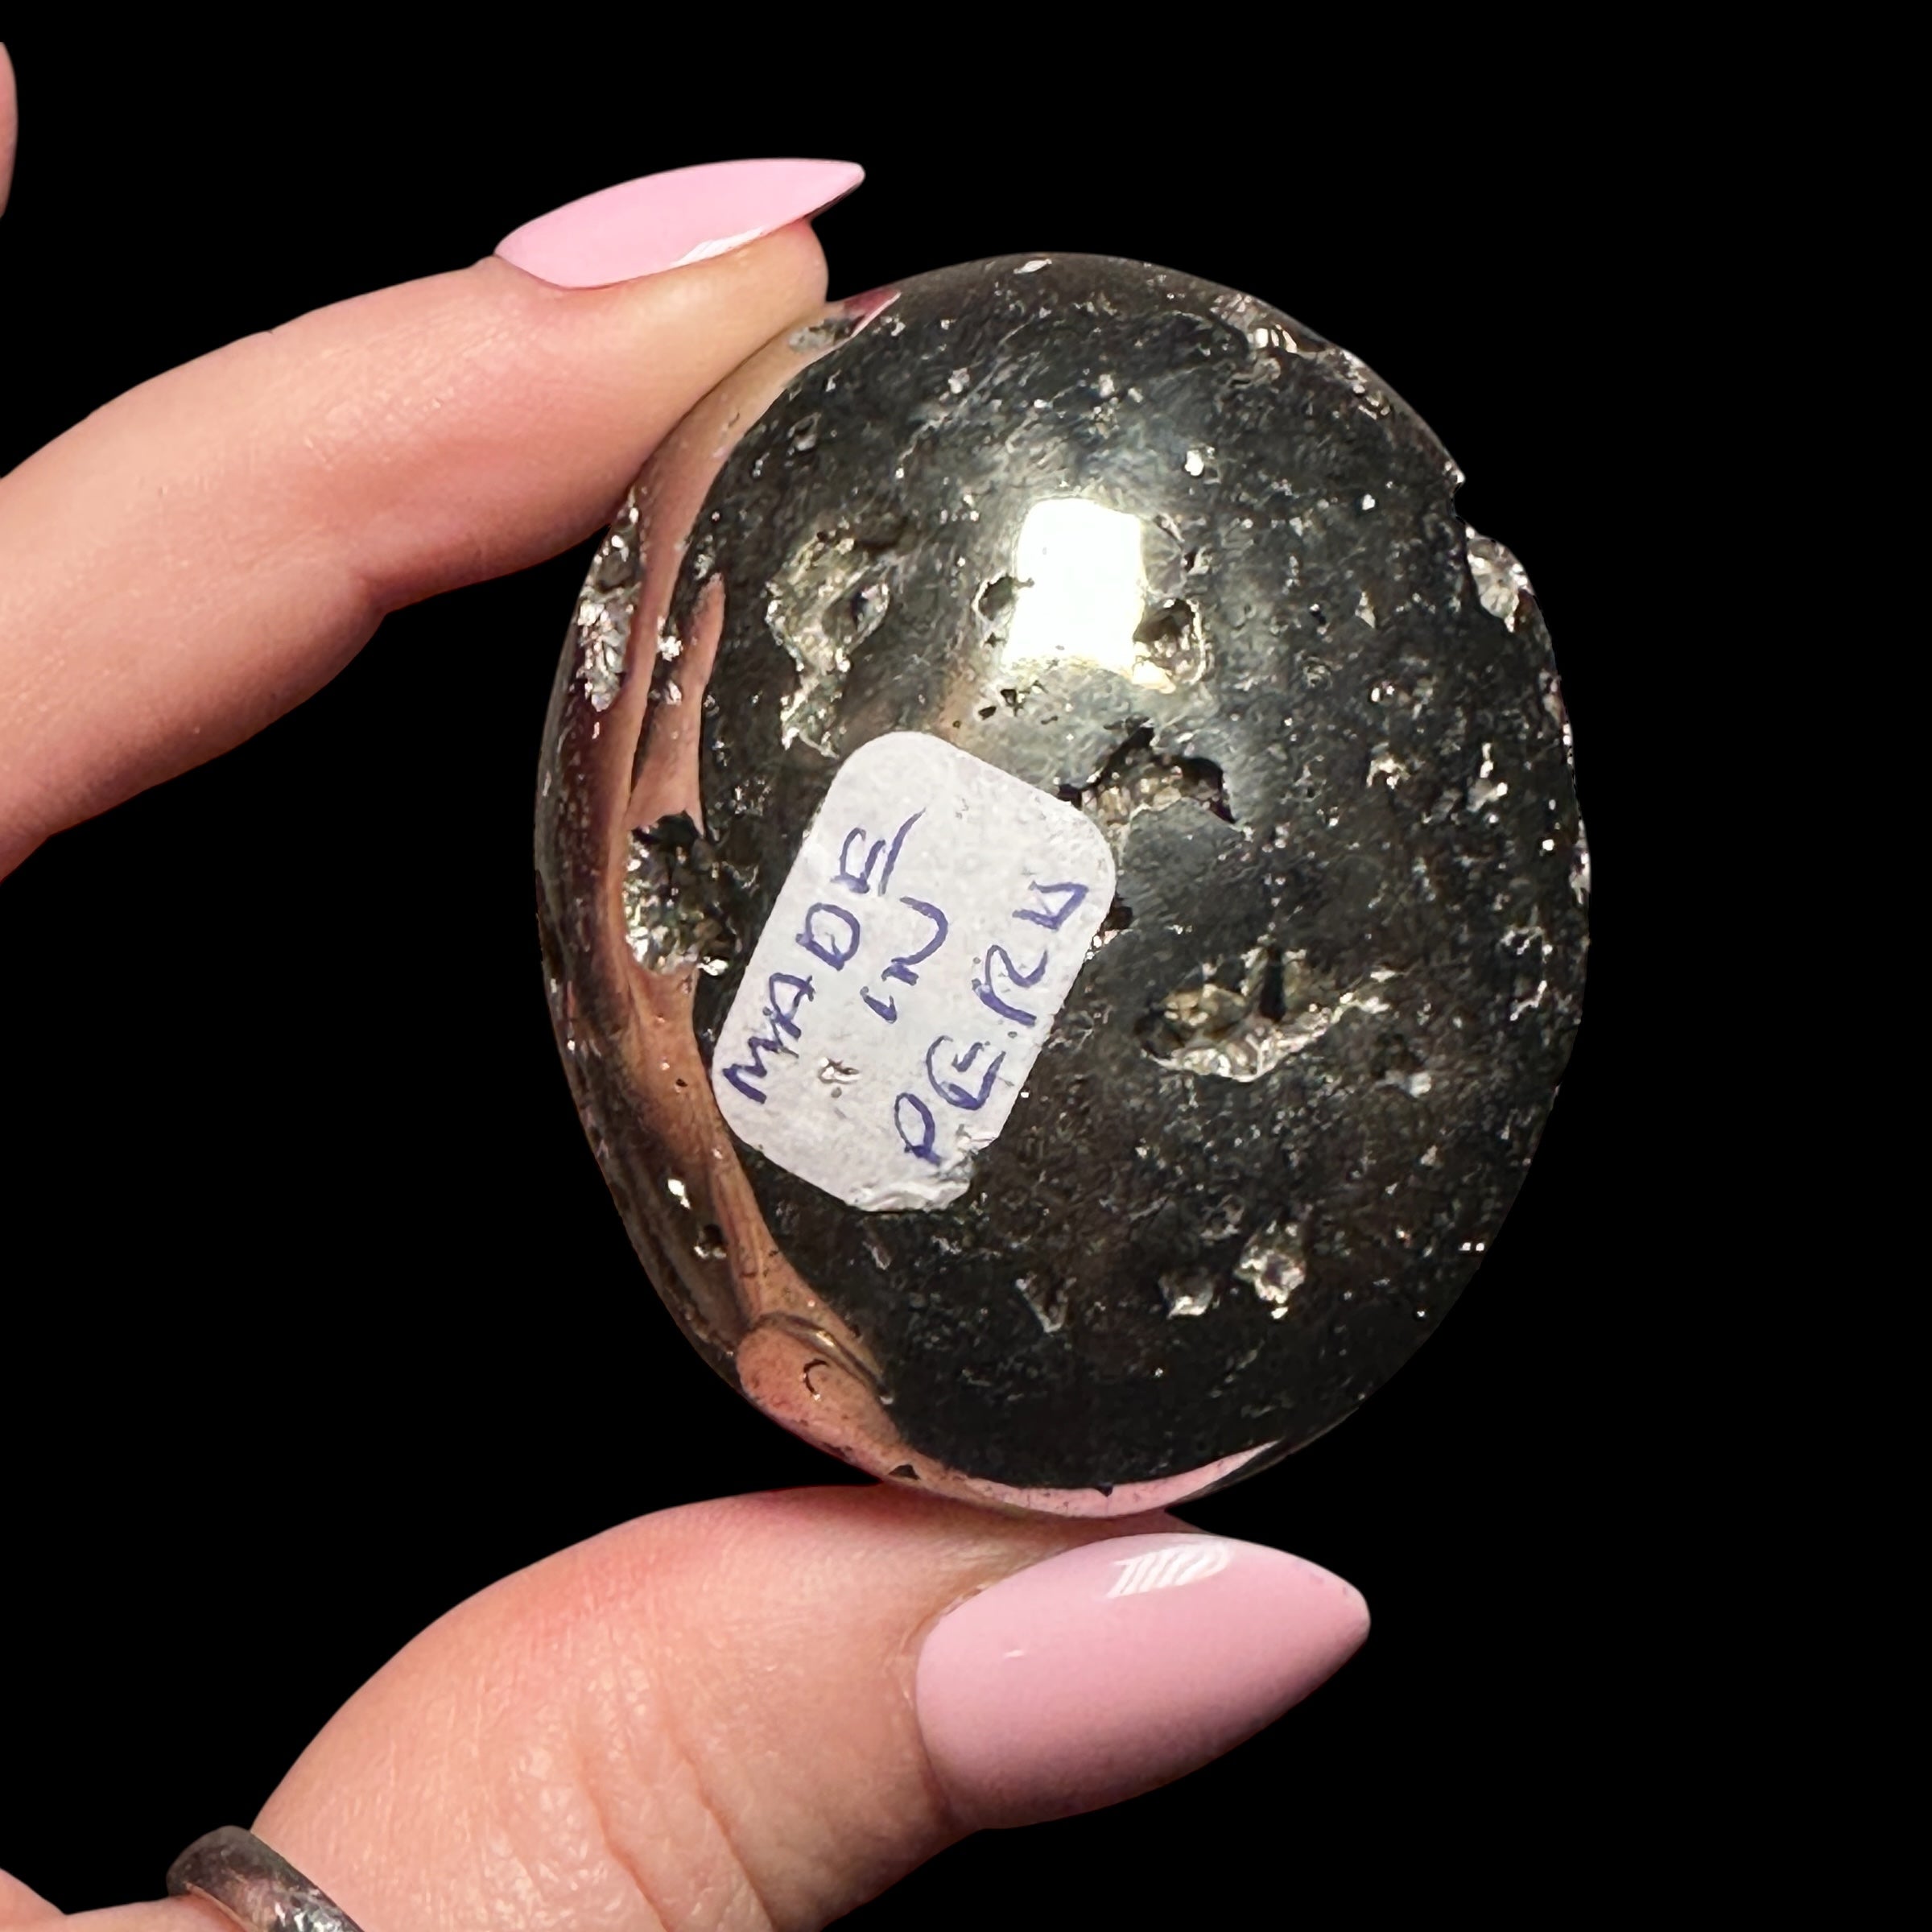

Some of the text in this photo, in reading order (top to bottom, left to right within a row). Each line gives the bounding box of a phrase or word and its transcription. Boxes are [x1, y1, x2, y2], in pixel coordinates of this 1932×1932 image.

[723, 807, 927, 1104] MADE
[860, 896, 949, 1024] IN
[894, 881, 1089, 1166] PERU
